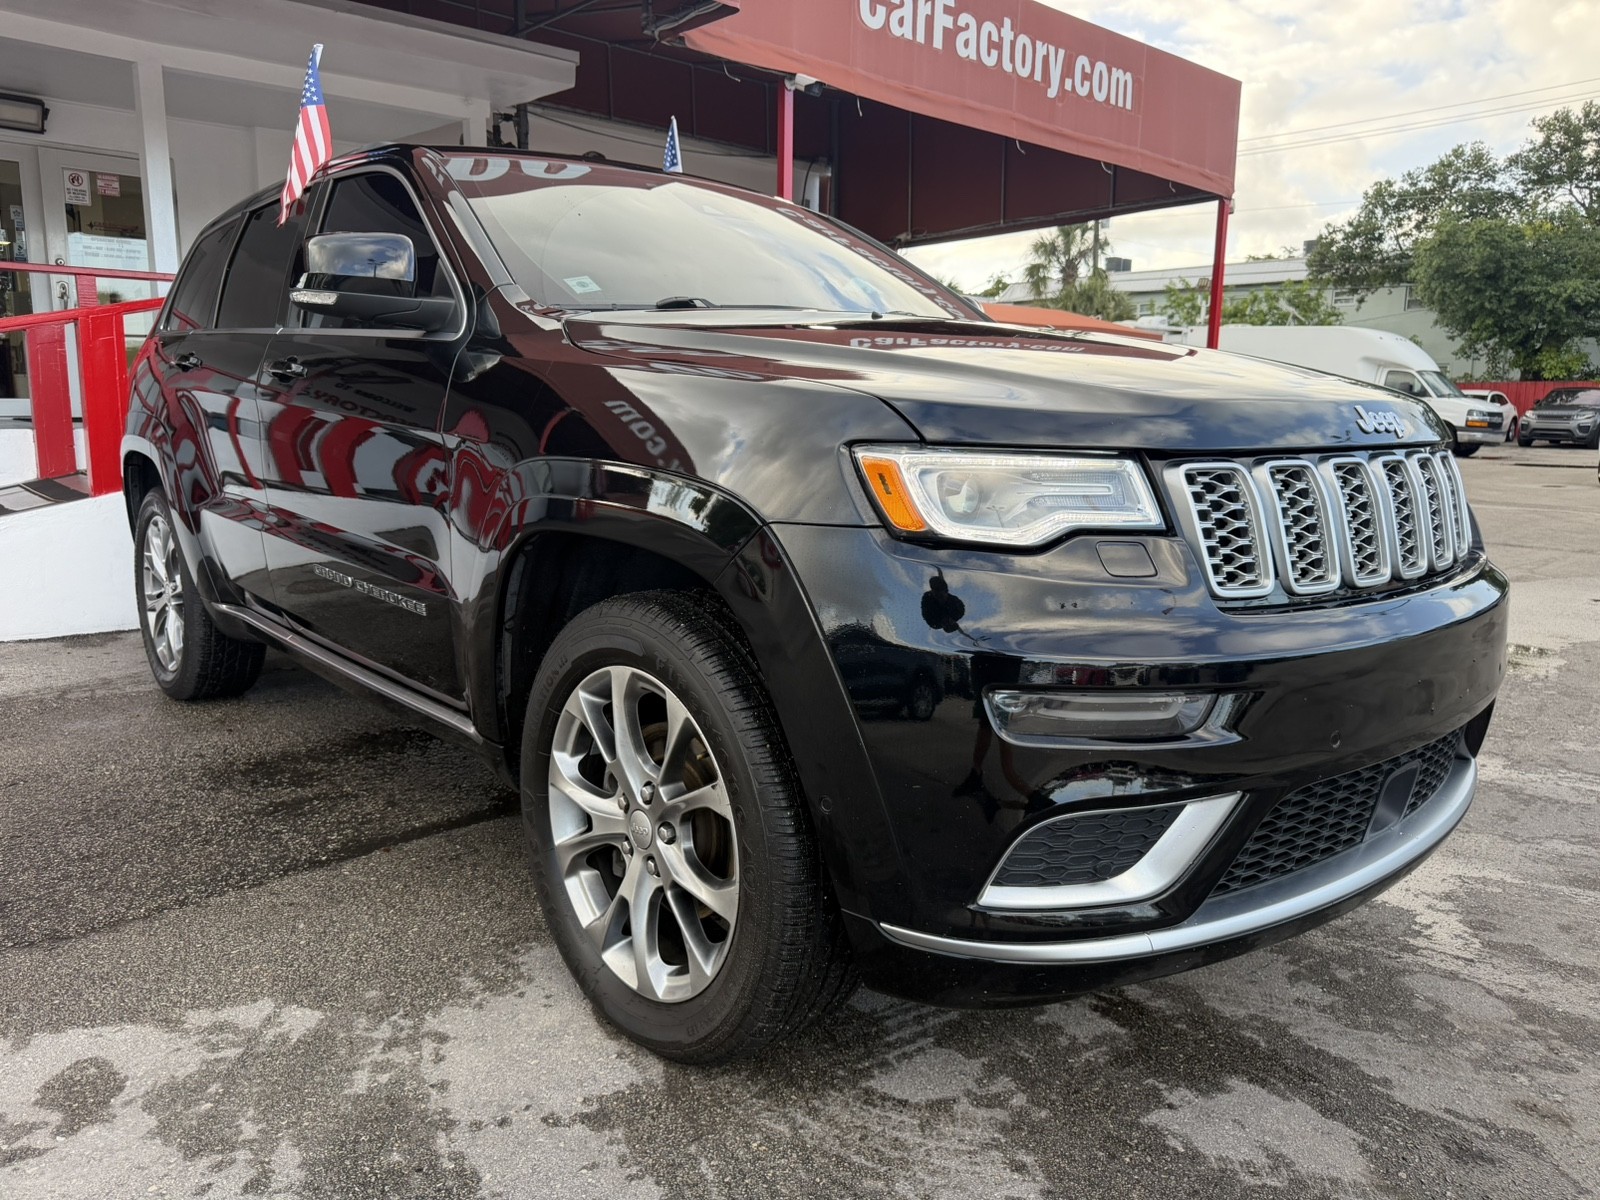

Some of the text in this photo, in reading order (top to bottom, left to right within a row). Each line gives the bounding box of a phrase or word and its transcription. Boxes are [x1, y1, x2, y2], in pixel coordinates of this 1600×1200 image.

[858, 0, 1134, 111] CarFactory.com
[1354, 404, 1404, 439] Jeep
[313, 563, 427, 617] GRAND CHEROKEE
